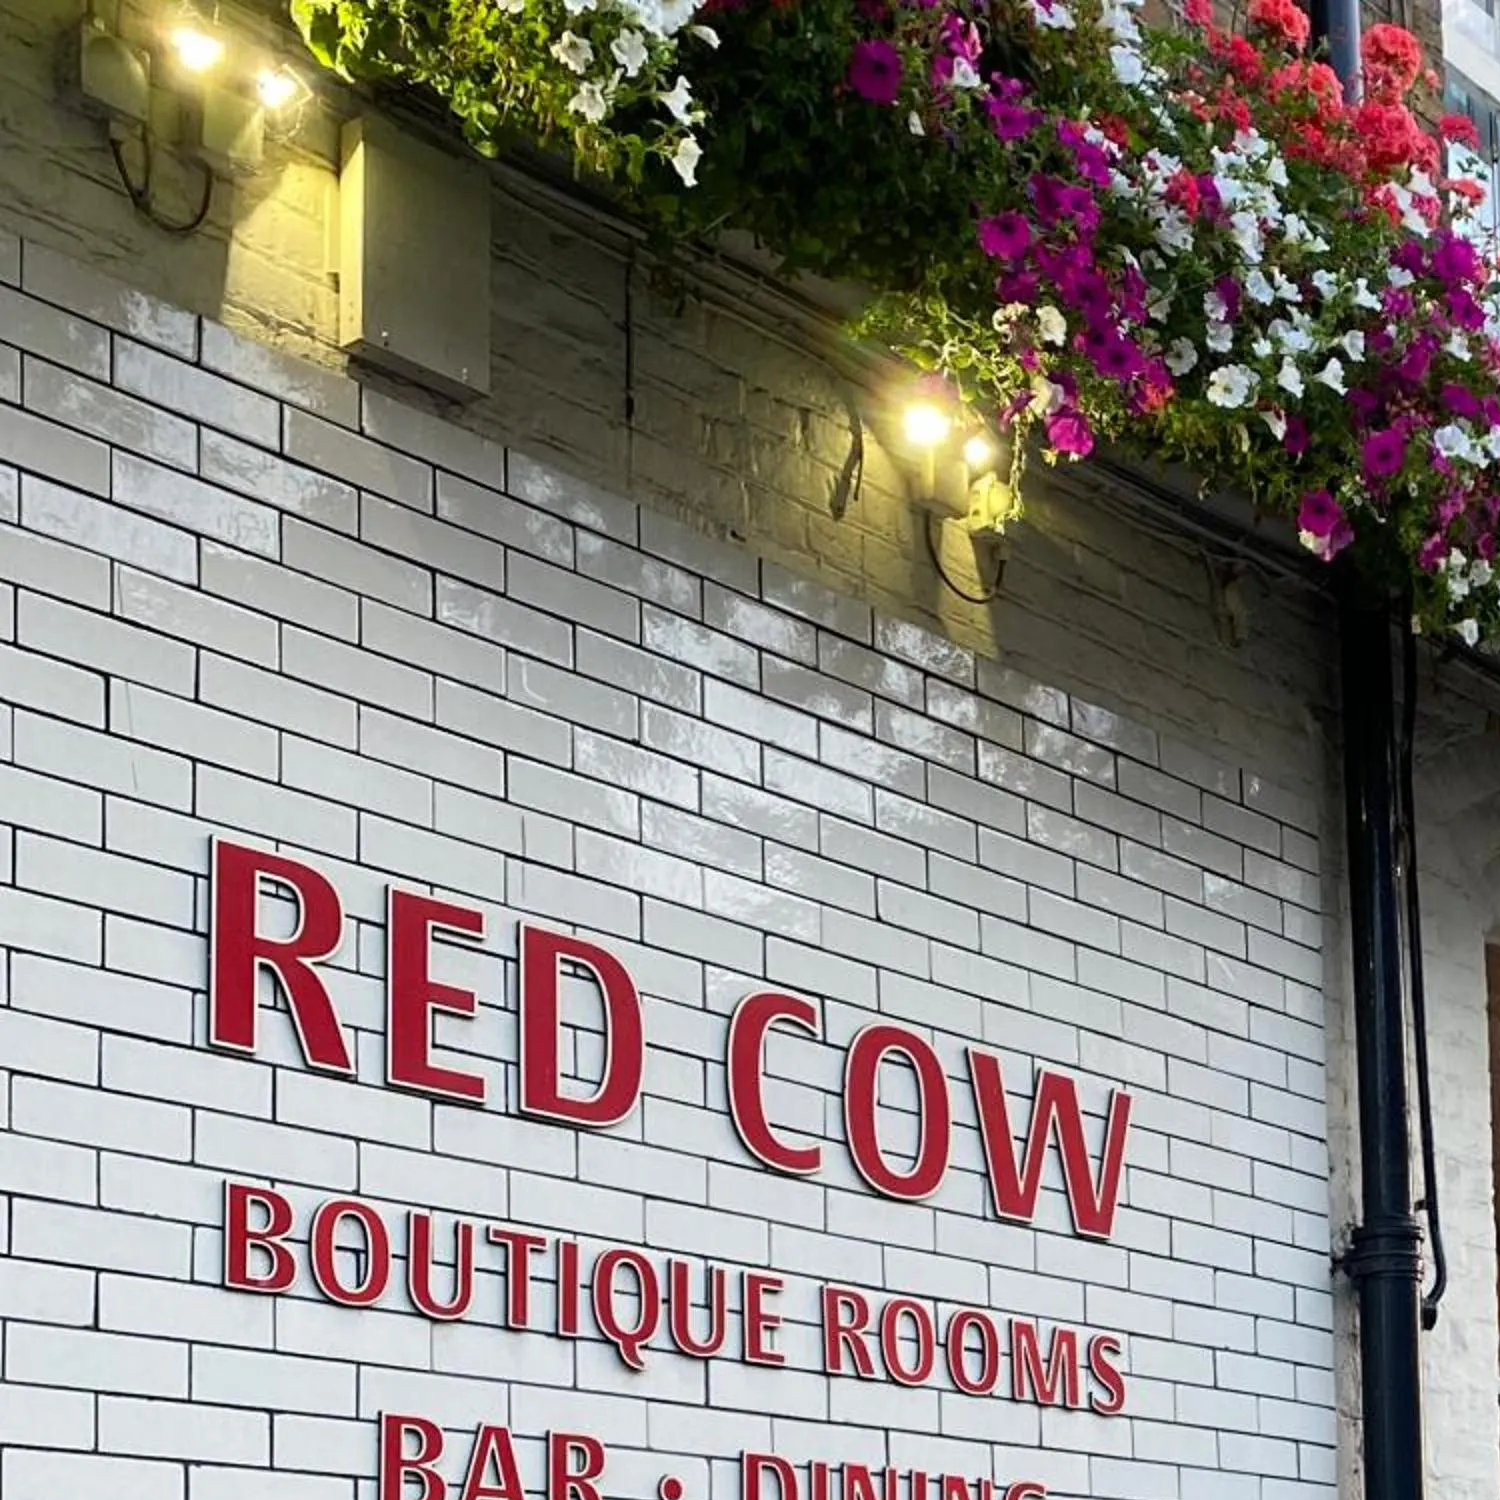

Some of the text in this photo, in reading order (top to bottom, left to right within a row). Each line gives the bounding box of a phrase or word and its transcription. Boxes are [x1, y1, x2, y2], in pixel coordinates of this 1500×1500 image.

[208, 834, 1134, 1241] RED COW
[222, 1179, 1129, 1416] BOUTIQUE ROOMS
